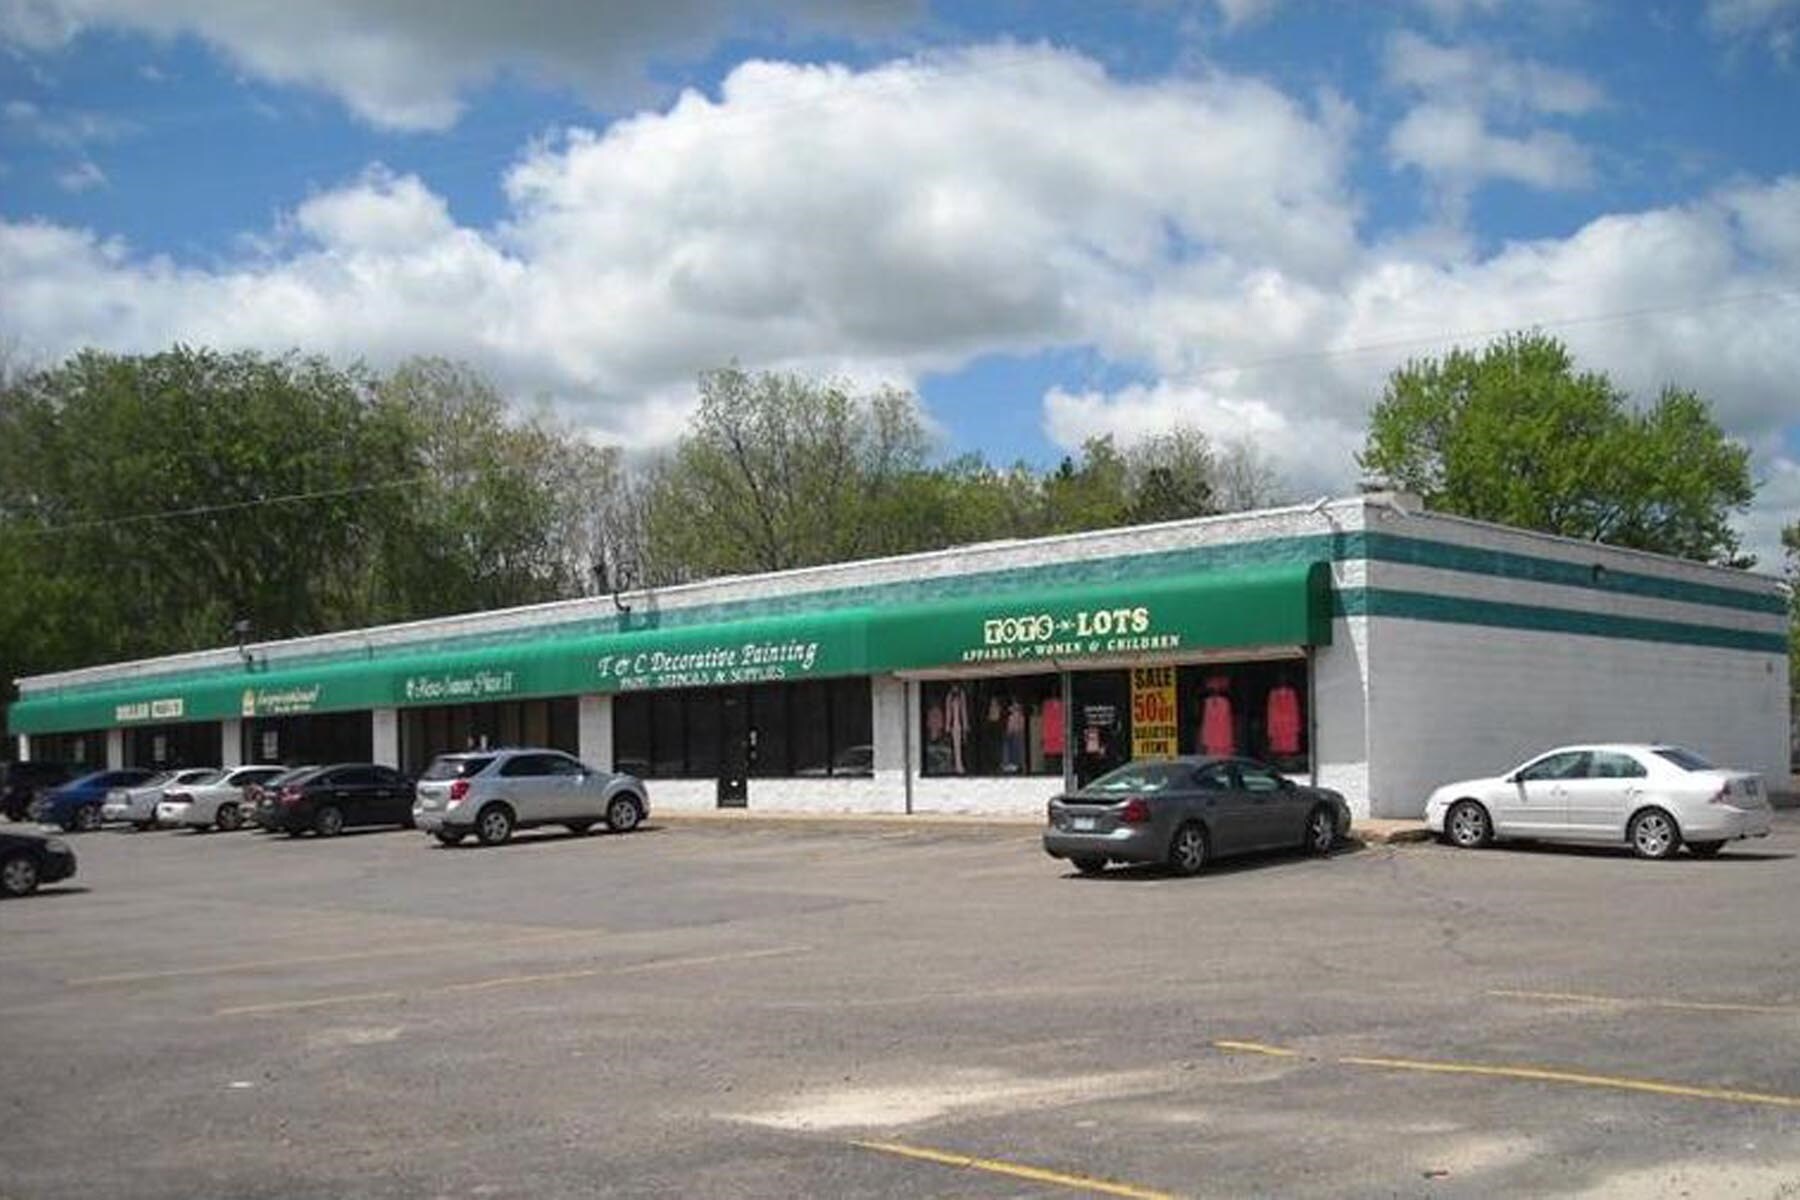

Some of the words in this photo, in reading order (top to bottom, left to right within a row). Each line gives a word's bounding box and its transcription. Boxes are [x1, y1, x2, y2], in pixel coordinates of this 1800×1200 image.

[985, 614, 1053, 644] TOTS
[1077, 607, 1149, 636] LOTS
[634, 654, 648, 674] C
[650, 645, 736, 672] Decorative
[740, 638, 819, 669] Painting
[1035, 642, 1081, 655] WOMEN
[1107, 634, 1181, 651] CHILDREN
[1134, 667, 1173, 689] SALE
